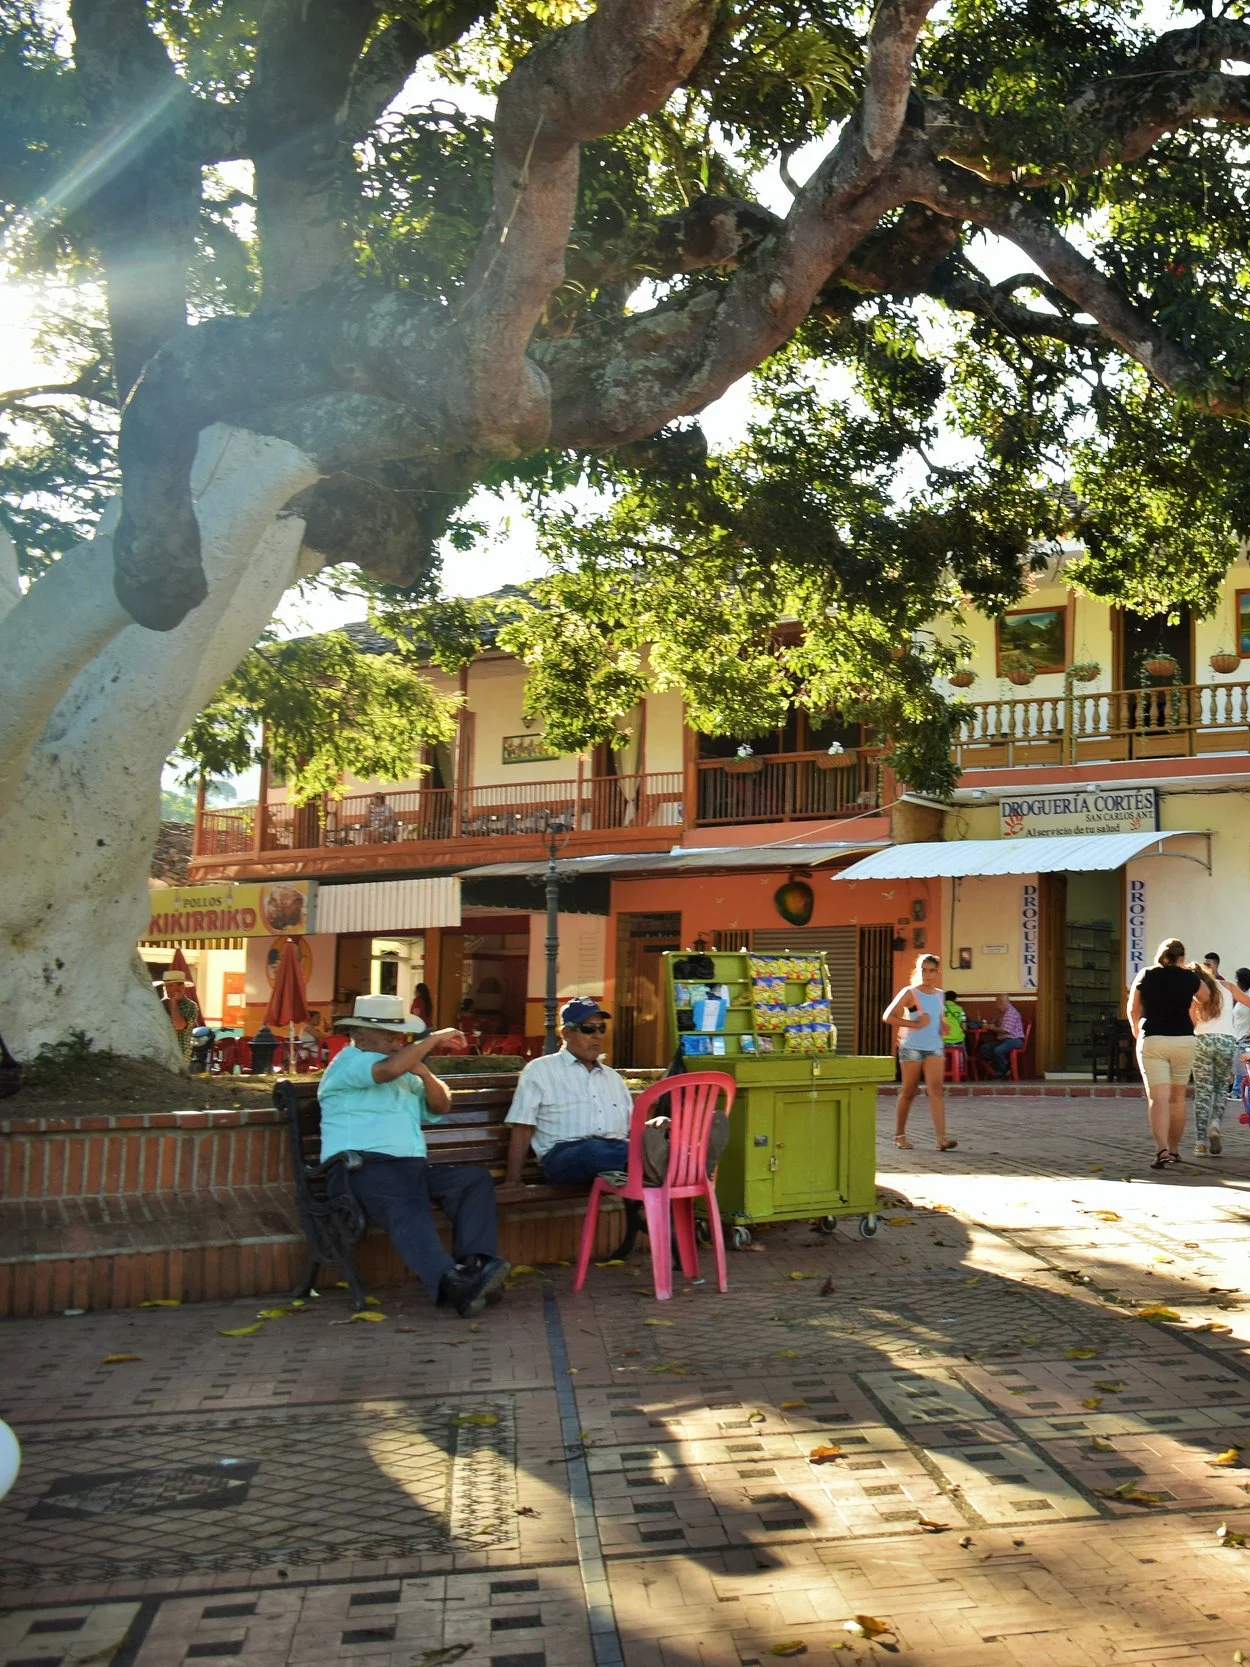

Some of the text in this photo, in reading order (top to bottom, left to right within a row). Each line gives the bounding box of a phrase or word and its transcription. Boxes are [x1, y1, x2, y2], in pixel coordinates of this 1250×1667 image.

[1001, 789, 1153, 817] DROGUERÍA CORTÉS
[1085, 813, 1102, 822] SAN
[1103, 812, 1134, 821] CARLOS
[1026, 823, 1120, 837] Al servicio de tu salud
[183, 897, 222, 909] POLLOS
[148, 908, 257, 936] KIKIRRIKO
[1129, 880, 1146, 986] DROGUERI
[1023, 885, 1038, 988] DROGUERIA
